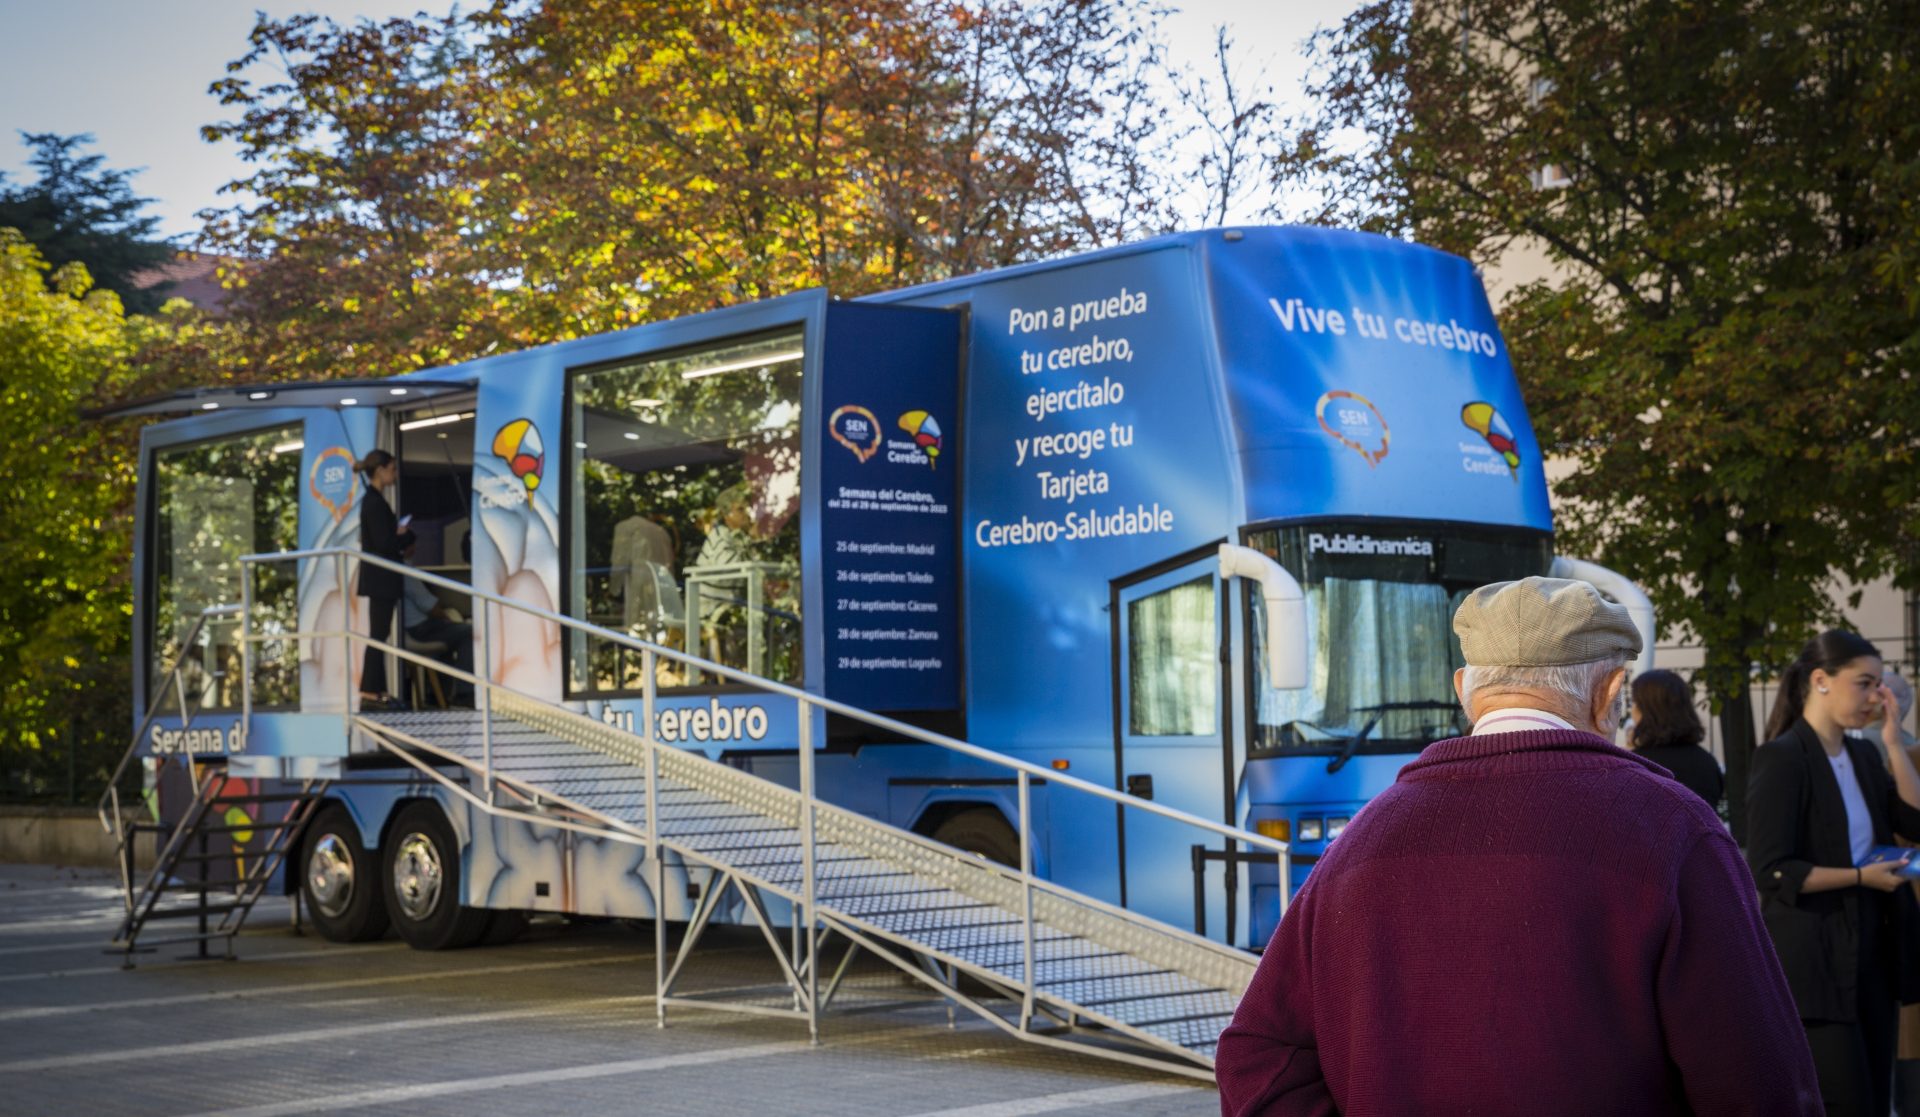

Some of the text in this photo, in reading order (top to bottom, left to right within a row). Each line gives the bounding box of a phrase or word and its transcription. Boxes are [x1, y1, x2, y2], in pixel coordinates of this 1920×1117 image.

[1009, 288, 1148, 335] Pon a prueba
[1269, 298, 1497, 358] Vive tu cerebro
[1021, 335, 1134, 375] tu cerebro,
[1026, 376, 1125, 422] ejercítalo
[845, 419, 868, 433] SEN
[1338, 409, 1368, 426] SEN
[1015, 422, 1134, 467] y recoge tu
[887, 450, 929, 465] Cerebro
[323, 466, 345, 483] SEN
[1462, 457, 1510, 477] Cerebro
[839, 486, 935, 504] Semana del Cerebro,
[1037, 469, 1109, 504] Tarjeta
[828, 499, 840, 508] del
[870, 501, 879, 511] de
[880, 502, 919, 514] septiembre
[920, 504, 929, 513] de
[975, 503, 1174, 549] Cerebro-Saludable
[836, 540, 934, 555] 25 de septiembre: Madrid
[837, 569, 934, 584] 26 de septiembre: Toledo
[837, 598, 938, 613] 27 de septiembre: Cáceres
[838, 627, 938, 642] 28 de septiembre: Zamora
[838, 657, 942, 671] 29 de septiembre: Logroño
[654, 698, 768, 741] erebro
